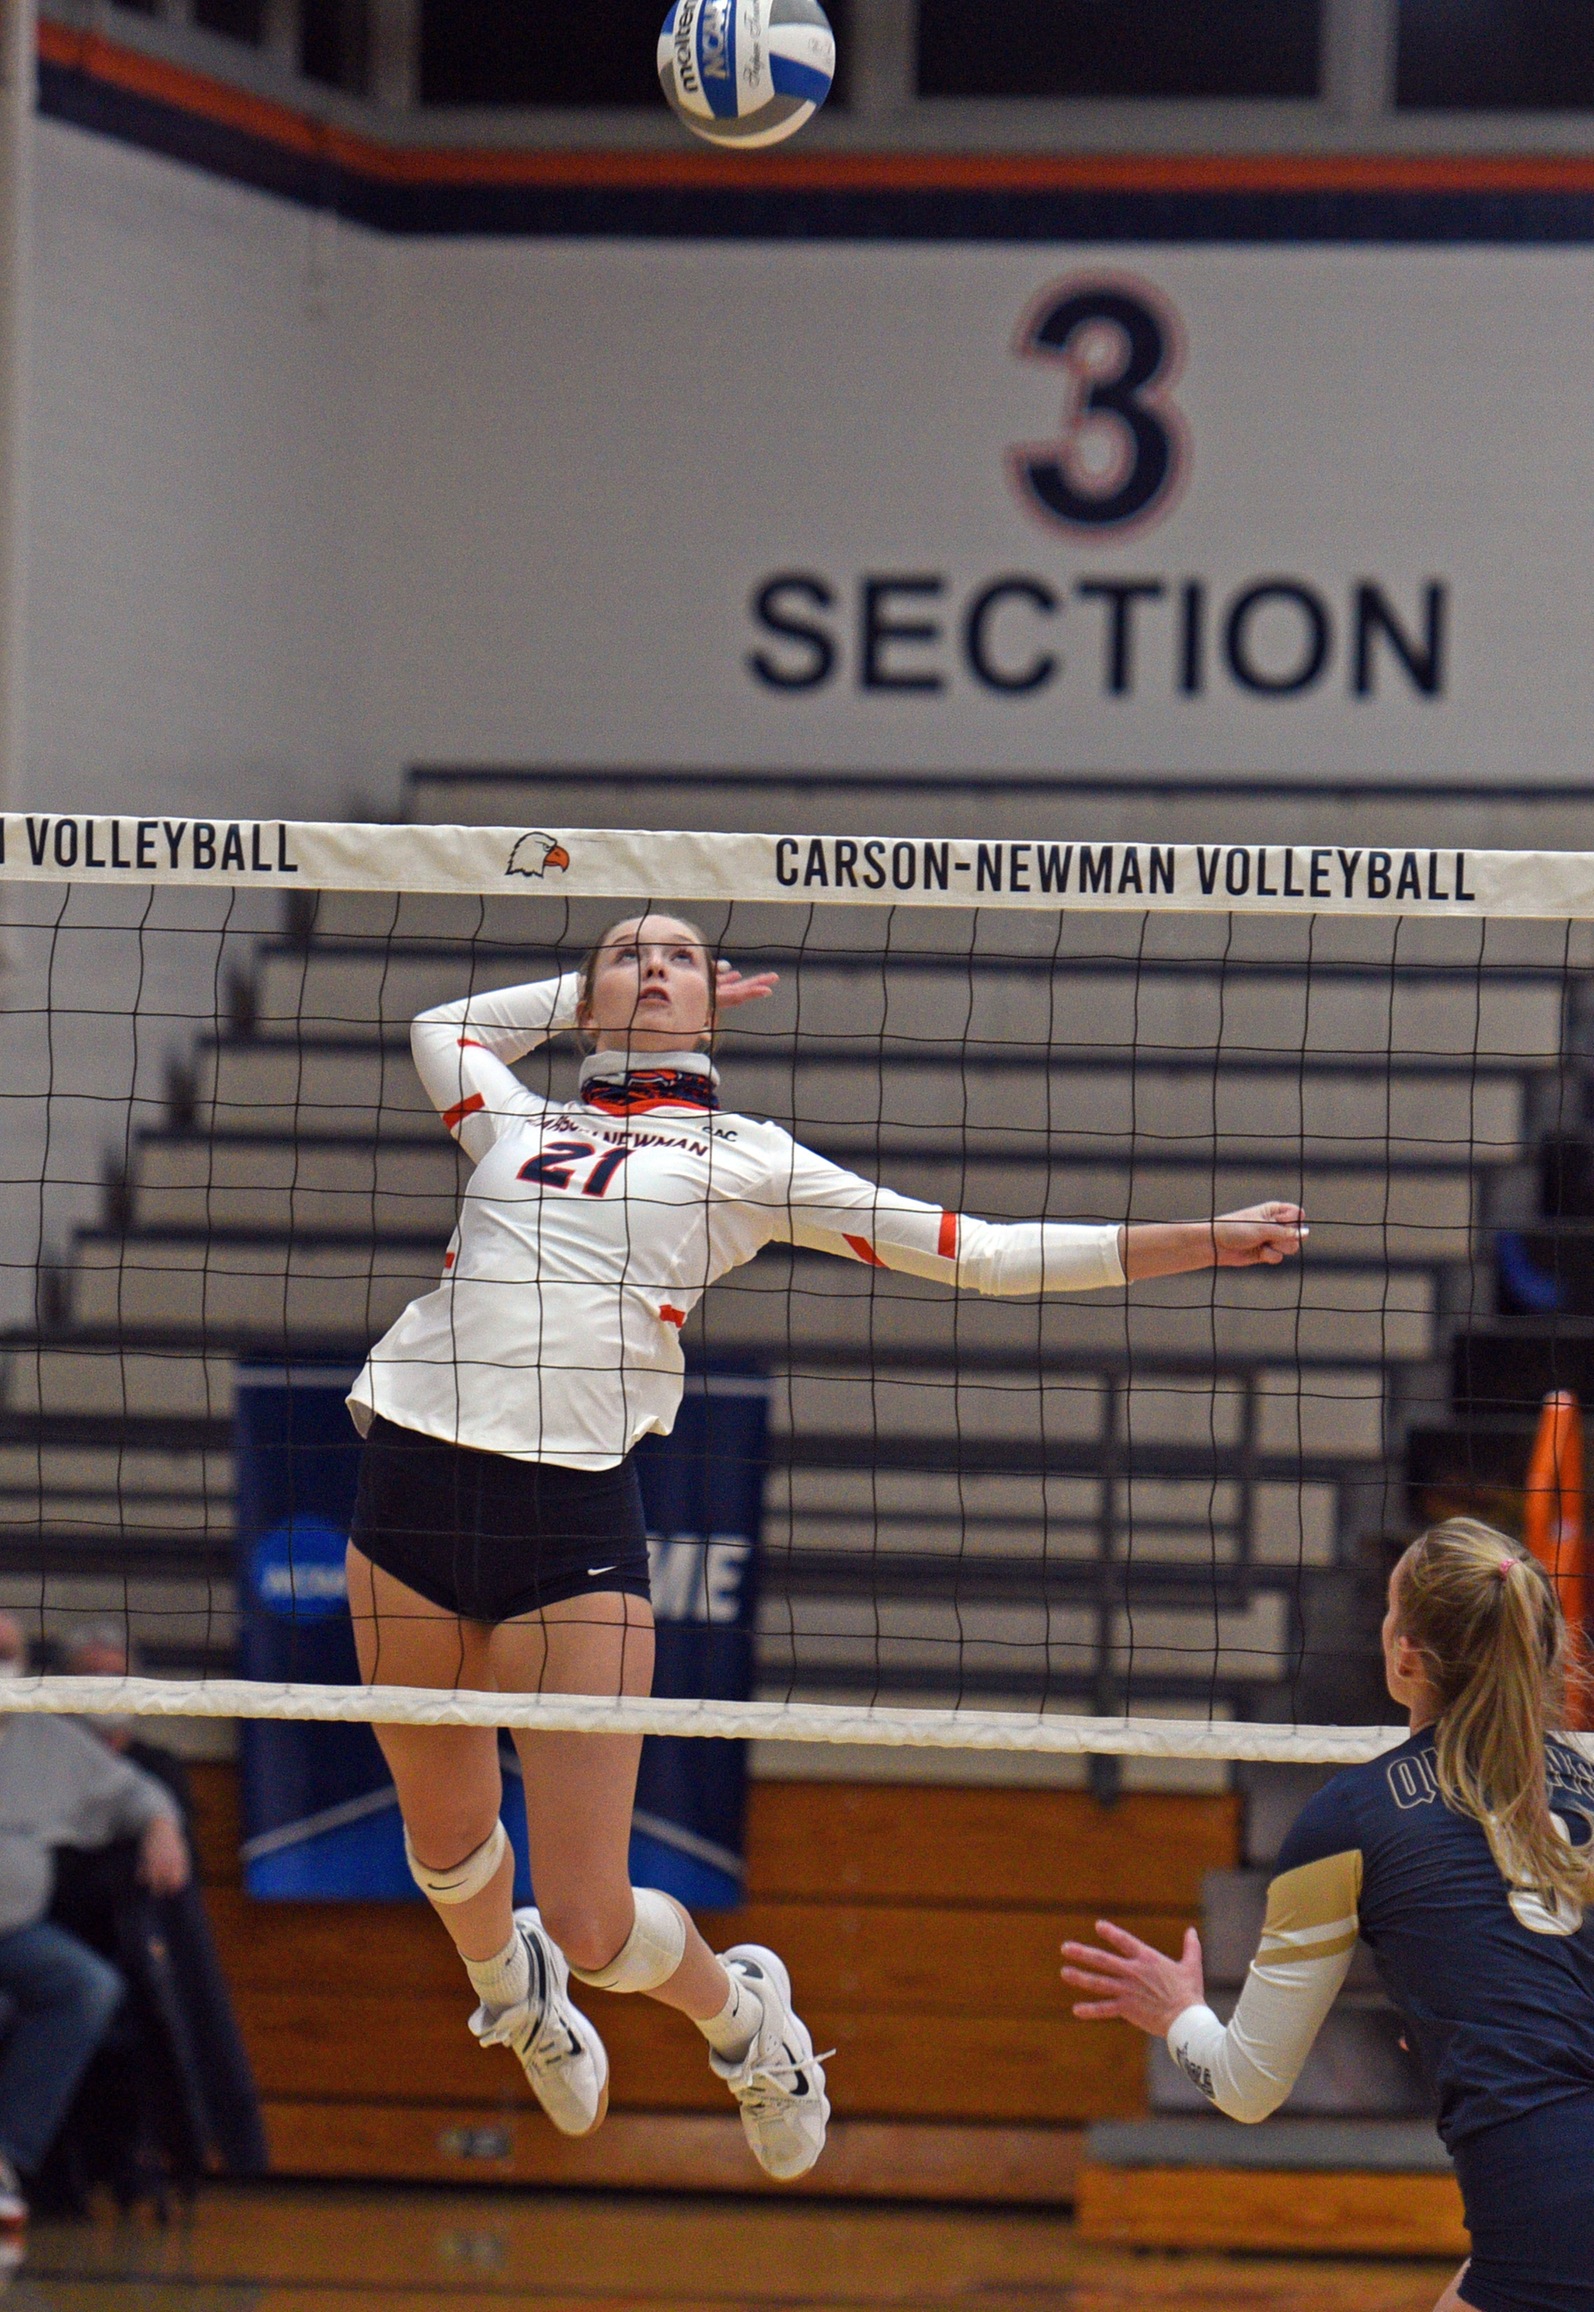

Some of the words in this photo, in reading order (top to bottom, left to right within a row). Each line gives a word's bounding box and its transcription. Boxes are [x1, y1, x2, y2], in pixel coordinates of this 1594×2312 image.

[1008, 268, 1193, 545] 3
[748, 573, 1450, 697] SECTION
[26, 817, 298, 872] VOLLEYBALL
[776, 837, 1175, 894] CARSON-NEWMAN
[1196, 846, 1476, 901] VOLLEYBALL
[516, 1141, 634, 1198] 21
